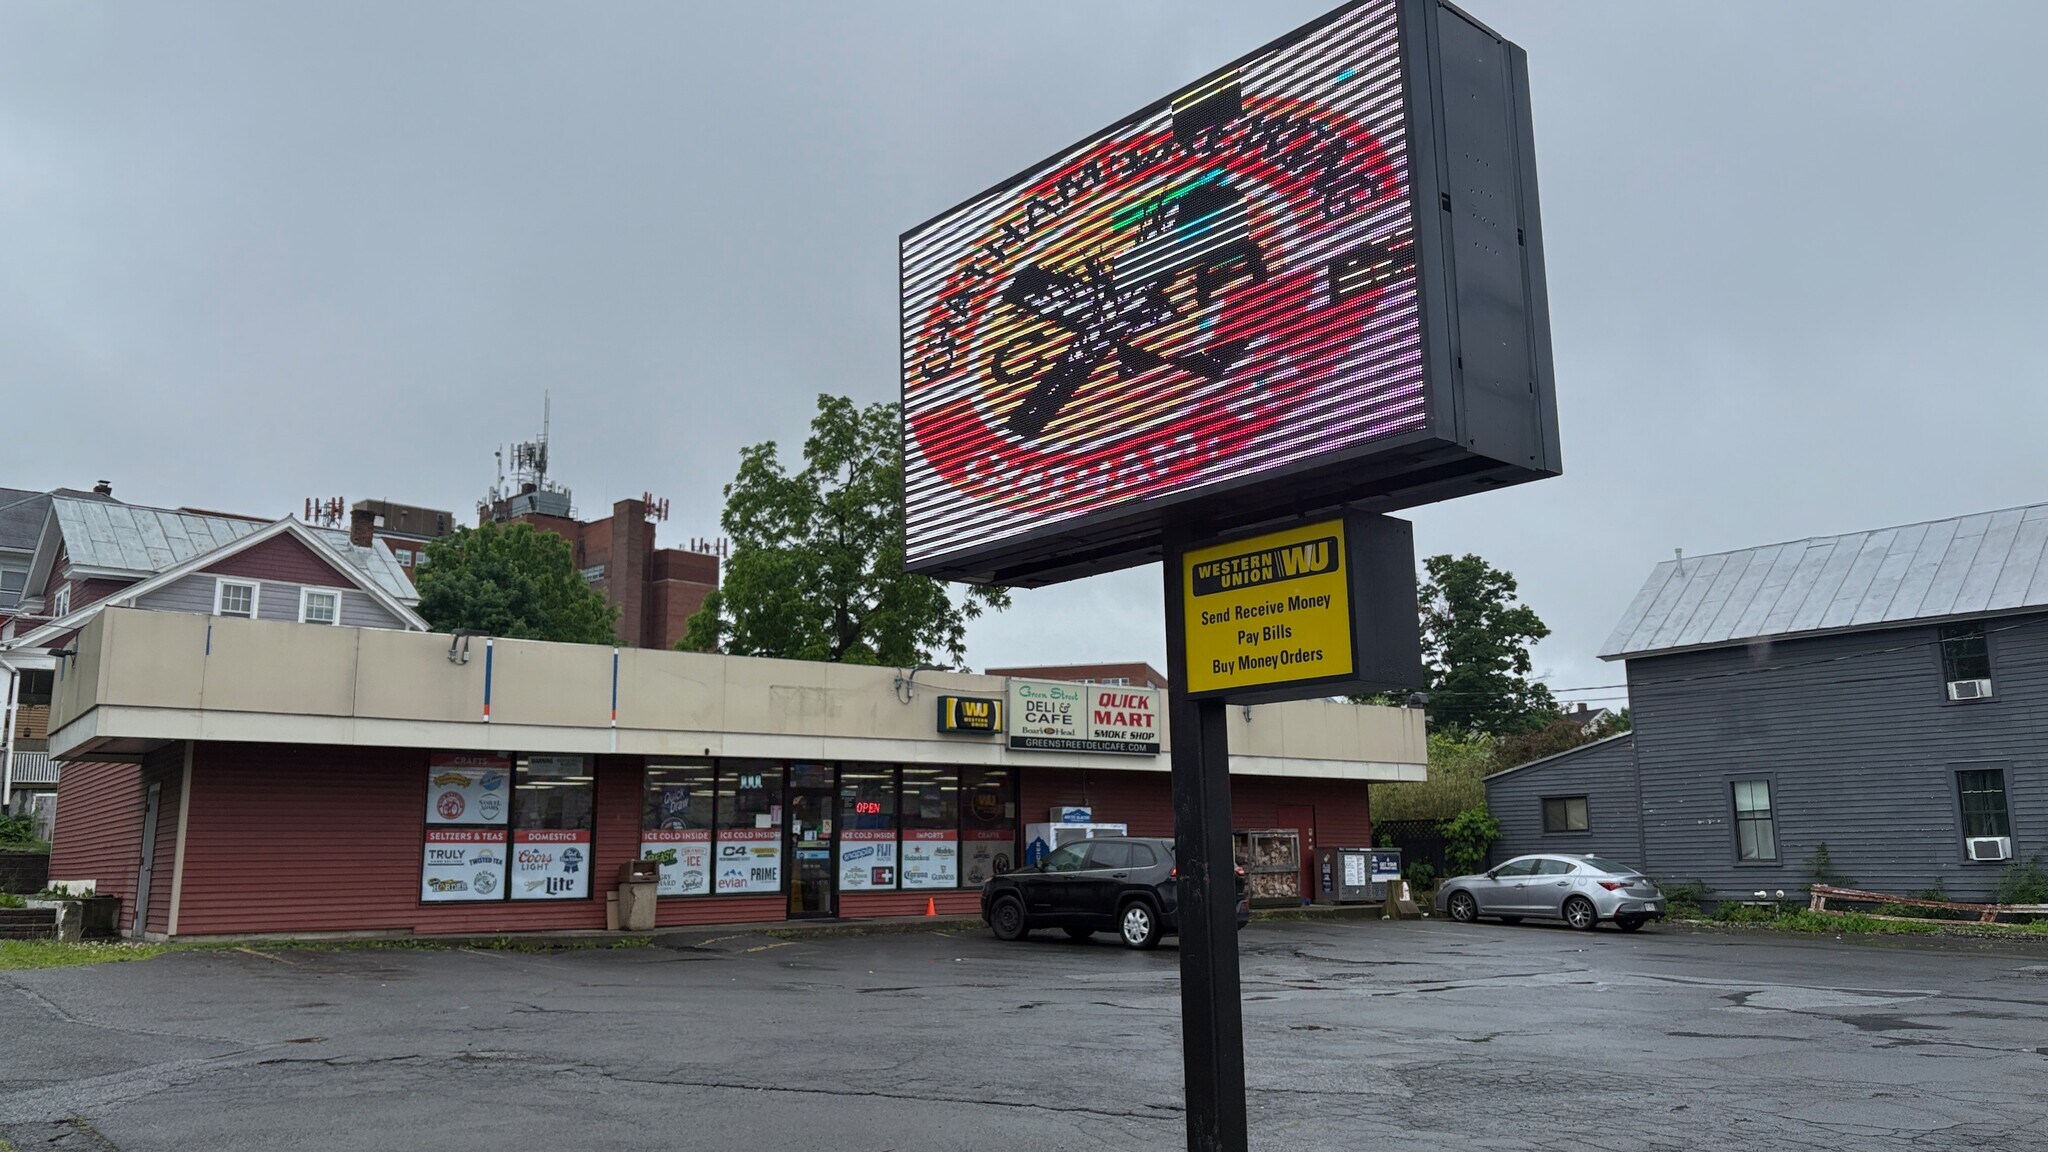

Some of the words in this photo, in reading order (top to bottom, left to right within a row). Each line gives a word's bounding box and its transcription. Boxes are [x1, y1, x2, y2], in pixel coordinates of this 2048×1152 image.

[1281, 541, 1330, 576] WU
[1199, 552, 1272, 579] WESTERN
[1221, 566, 1273, 588] UNION
[1201, 608, 1230, 626] Send
[1235, 601, 1284, 620] Receive
[1288, 594, 1331, 611] Money
[1238, 630, 1259, 646] Pay
[1263, 624, 1292, 641] Bills
[1213, 660, 1234, 675] Buy
[1238, 655, 1278, 670] Money
[1280, 648, 1323, 665] Orders
[1019, 686, 1046, 699] Green
[1050, 688, 1078, 700] Street
[1026, 701, 1056, 713] DELI
[1060, 704, 1070, 713] &
[1098, 692, 1149, 710] QUICK
[964, 702, 988, 716] WU
[1025, 713, 1072, 725] CAFE
[1094, 710, 1154, 728] MART
[1055, 728, 1075, 736] Head
[1094, 730, 1126, 739] SMOKE
[1130, 732, 1154, 740] SHOP
[1026, 738, 1147, 751] GREENSTREETDELICAFE.COM
[856, 802, 880, 814] OPEN
[644, 832, 658, 840] ICE
[660, 832, 681, 840] COLD
[683, 832, 708, 840] INSIDE
[734, 831, 753, 839] COLD
[756, 831, 780, 839] INSID
[428, 850, 466, 859] TRULY
[518, 850, 552, 863] Coors
[723, 846, 747, 856] C4
[877, 844, 891, 856] FIJI
[687, 856, 702, 866] ICE
[751, 867, 777, 881] PRIME
[545, 876, 574, 895] Lite
[718, 877, 747, 888] evian
